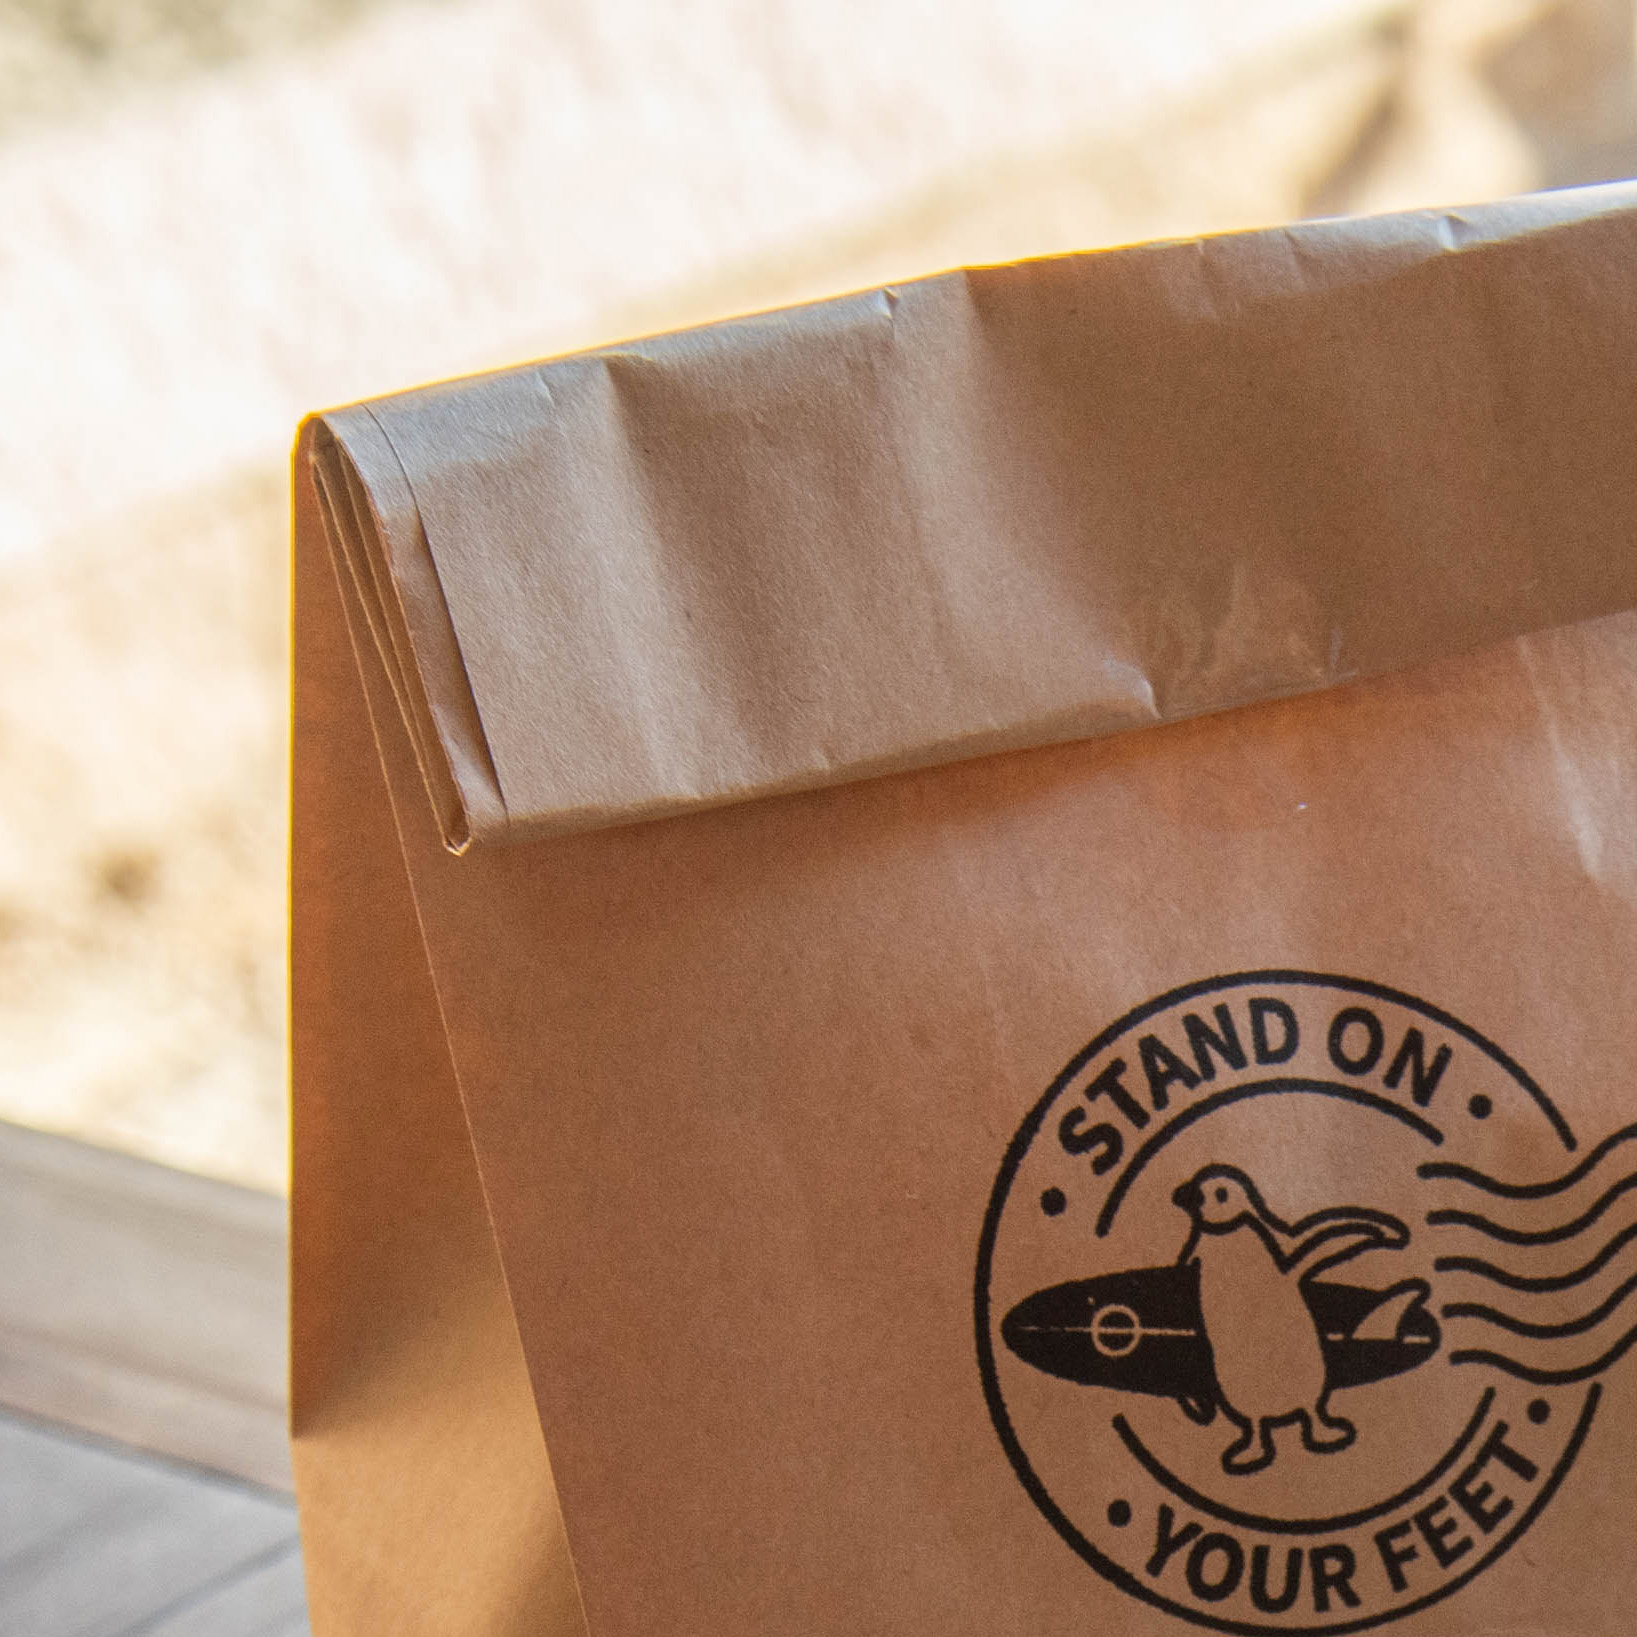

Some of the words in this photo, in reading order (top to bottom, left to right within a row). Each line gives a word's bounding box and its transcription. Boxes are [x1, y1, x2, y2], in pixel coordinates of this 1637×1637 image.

[1057, 998, 1301, 1177] STAND
[1326, 1006, 1454, 1107] ON
[1143, 1503, 1362, 1613] YOUR
[1374, 1421, 1539, 1592] FEET
